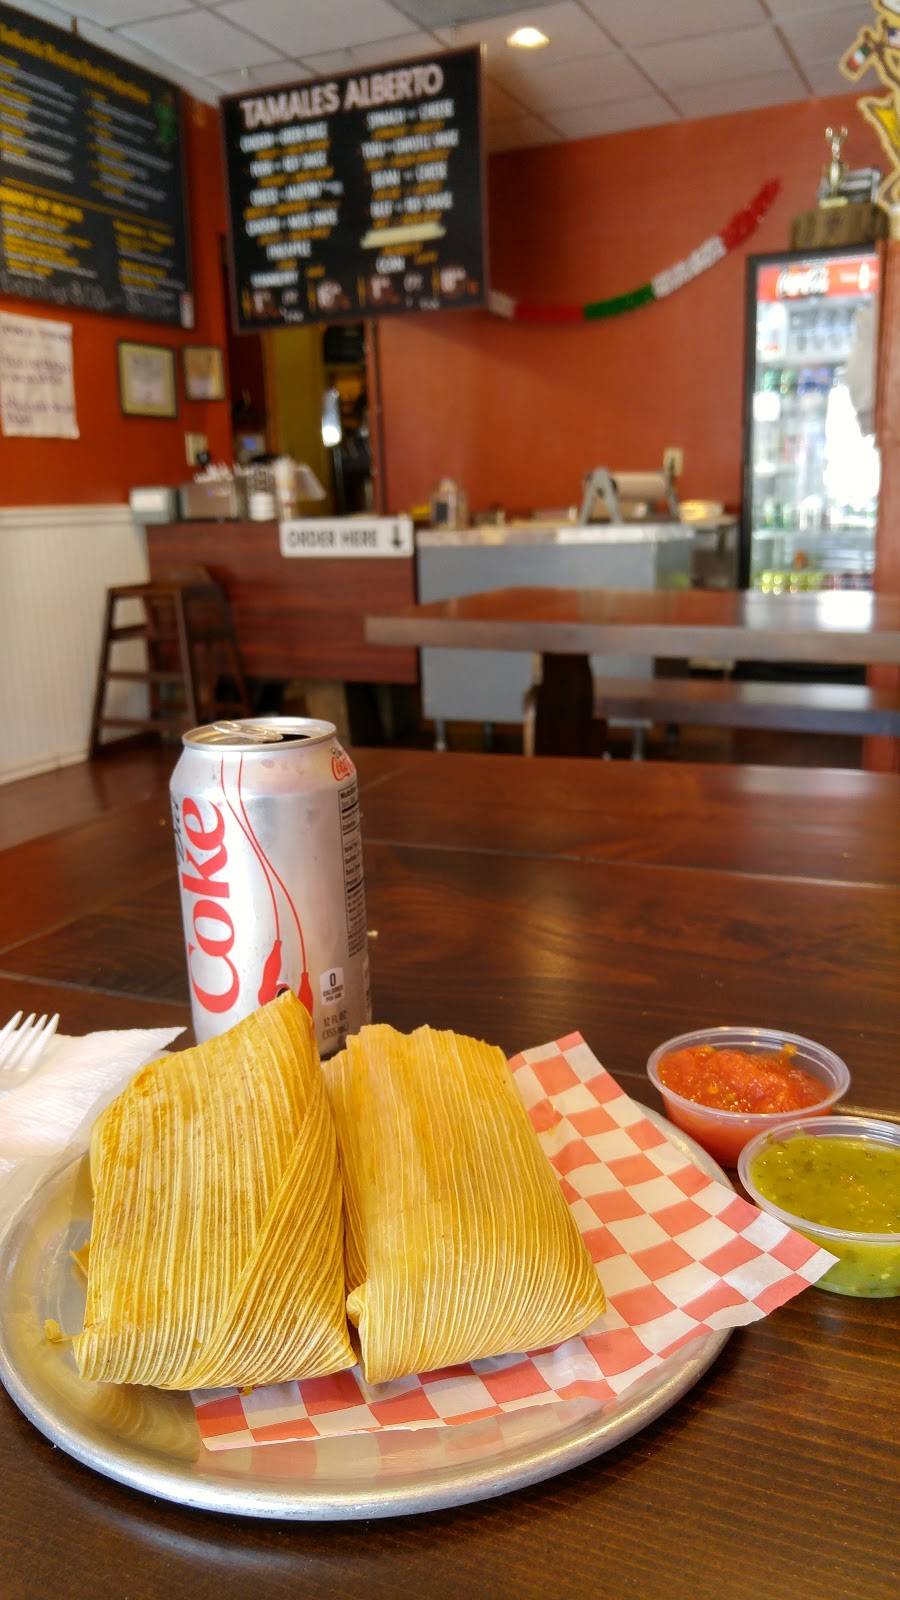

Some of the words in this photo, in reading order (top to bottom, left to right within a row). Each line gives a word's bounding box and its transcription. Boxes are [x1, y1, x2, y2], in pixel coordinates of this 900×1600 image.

[240, 82, 340, 129] TAMALES
[344, 64, 444, 110] ALBERTO
[287, 529, 336, 547] ORDER
[340, 529, 377, 547] HERE
[181, 796, 240, 1014] Coke
[329, 972, 337, 987] 0
